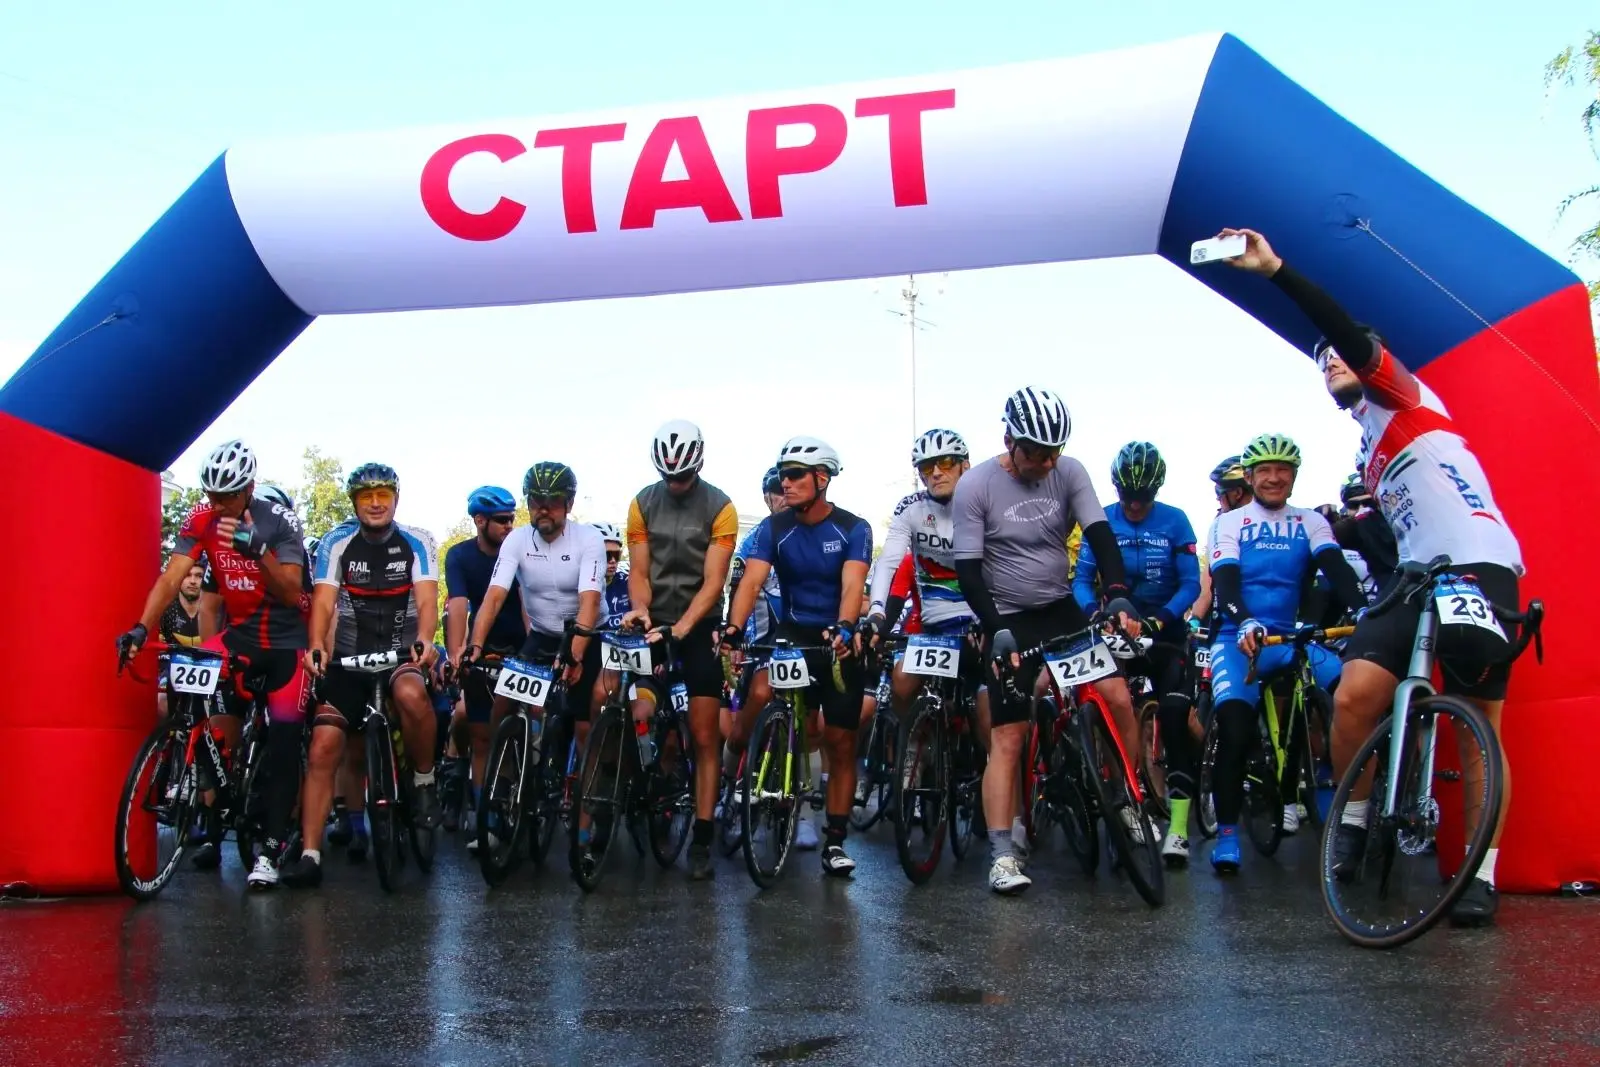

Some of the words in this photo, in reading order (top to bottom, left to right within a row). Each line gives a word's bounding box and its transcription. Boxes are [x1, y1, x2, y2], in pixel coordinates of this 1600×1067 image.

[420, 88, 956, 241] СТАРТ
[1240, 520, 1309, 542] ITALIA
[348, 561, 371, 573] RAIL
[915, 649, 951, 669] 152
[1058, 650, 1105, 680] 224
[175, 667, 211, 687] 260
[770, 661, 802, 681] 106
[503, 673, 543, 698] 400
